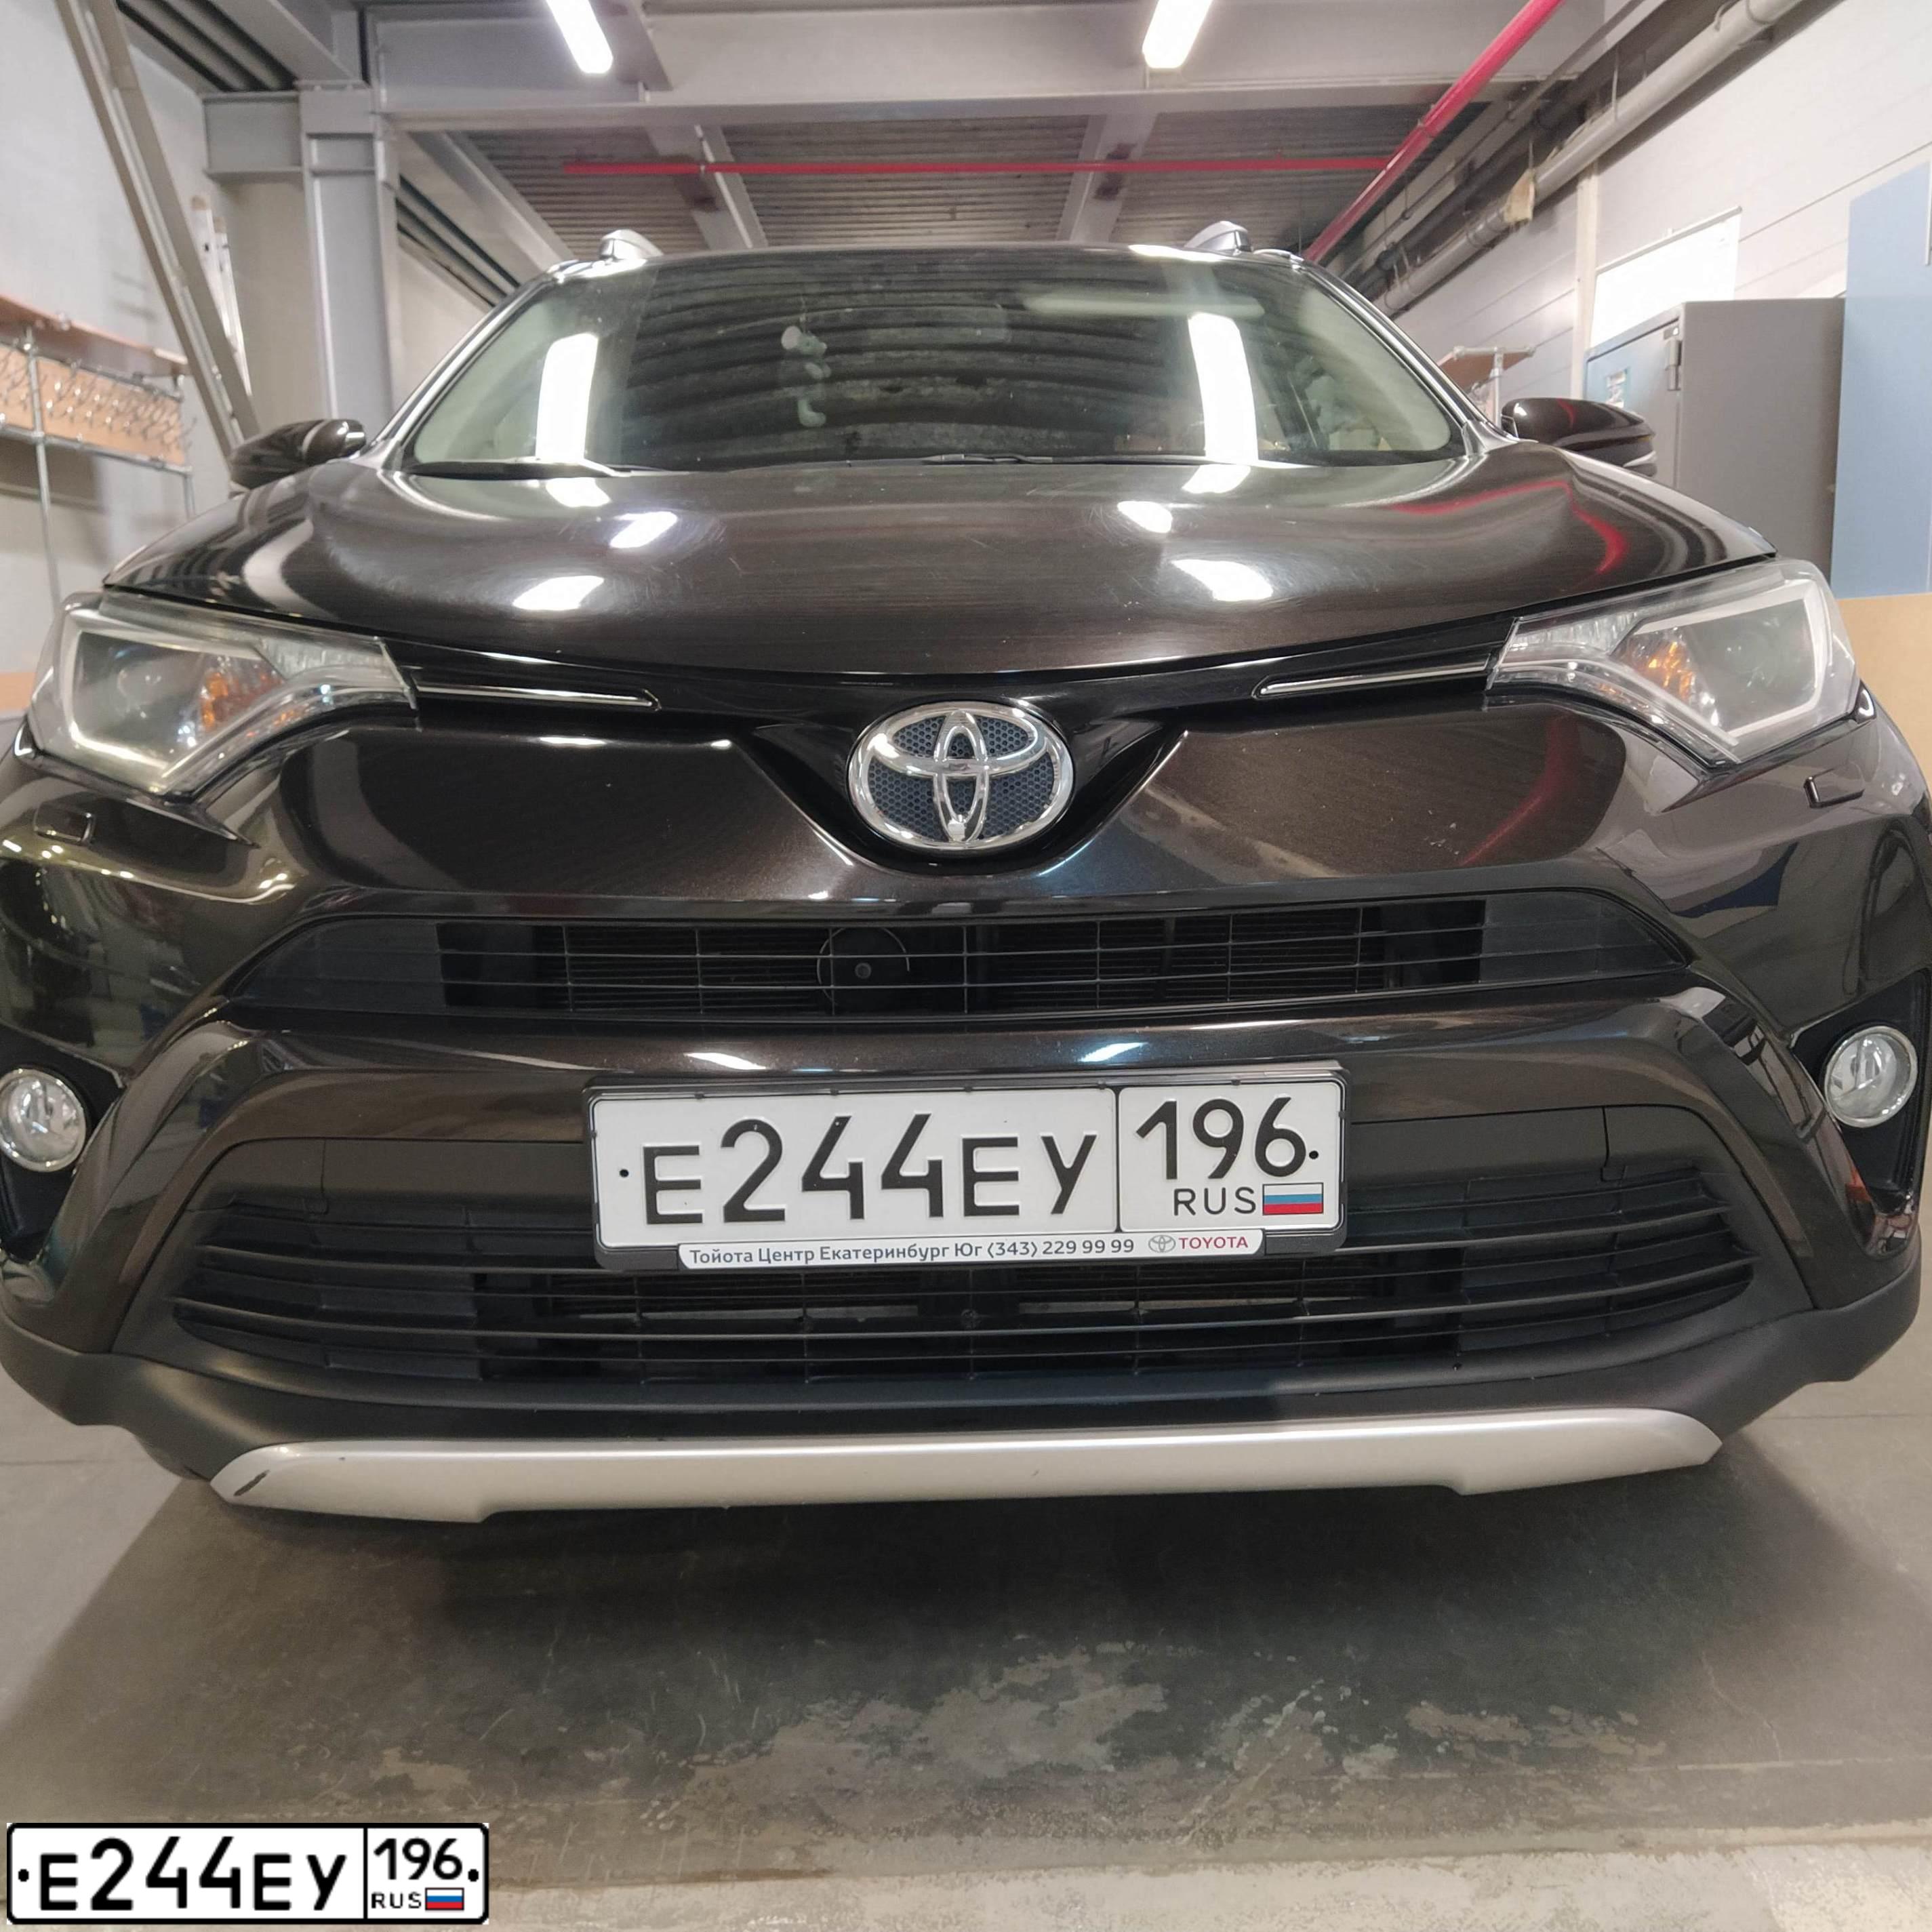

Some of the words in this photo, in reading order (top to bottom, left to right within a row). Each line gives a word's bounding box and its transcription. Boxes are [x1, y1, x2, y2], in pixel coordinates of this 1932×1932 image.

[1135, 1096, 1306, 1180] 196
[1173, 1186, 1257, 1217] RUS
[689, 1248, 753, 1264] Тойота
[758, 1247, 814, 1264] Центр
[820, 1243, 950, 1262] Екатеринбург
[954, 1243, 982, 1257] Юг
[987, 1241, 1037, 1258] (343)
[1043, 1241, 1076, 1255] 229
[1083, 1240, 1106, 1254] 99
[1111, 1239, 1134, 1253] 99
[1179, 1236, 1249, 1249] TOYOTA
